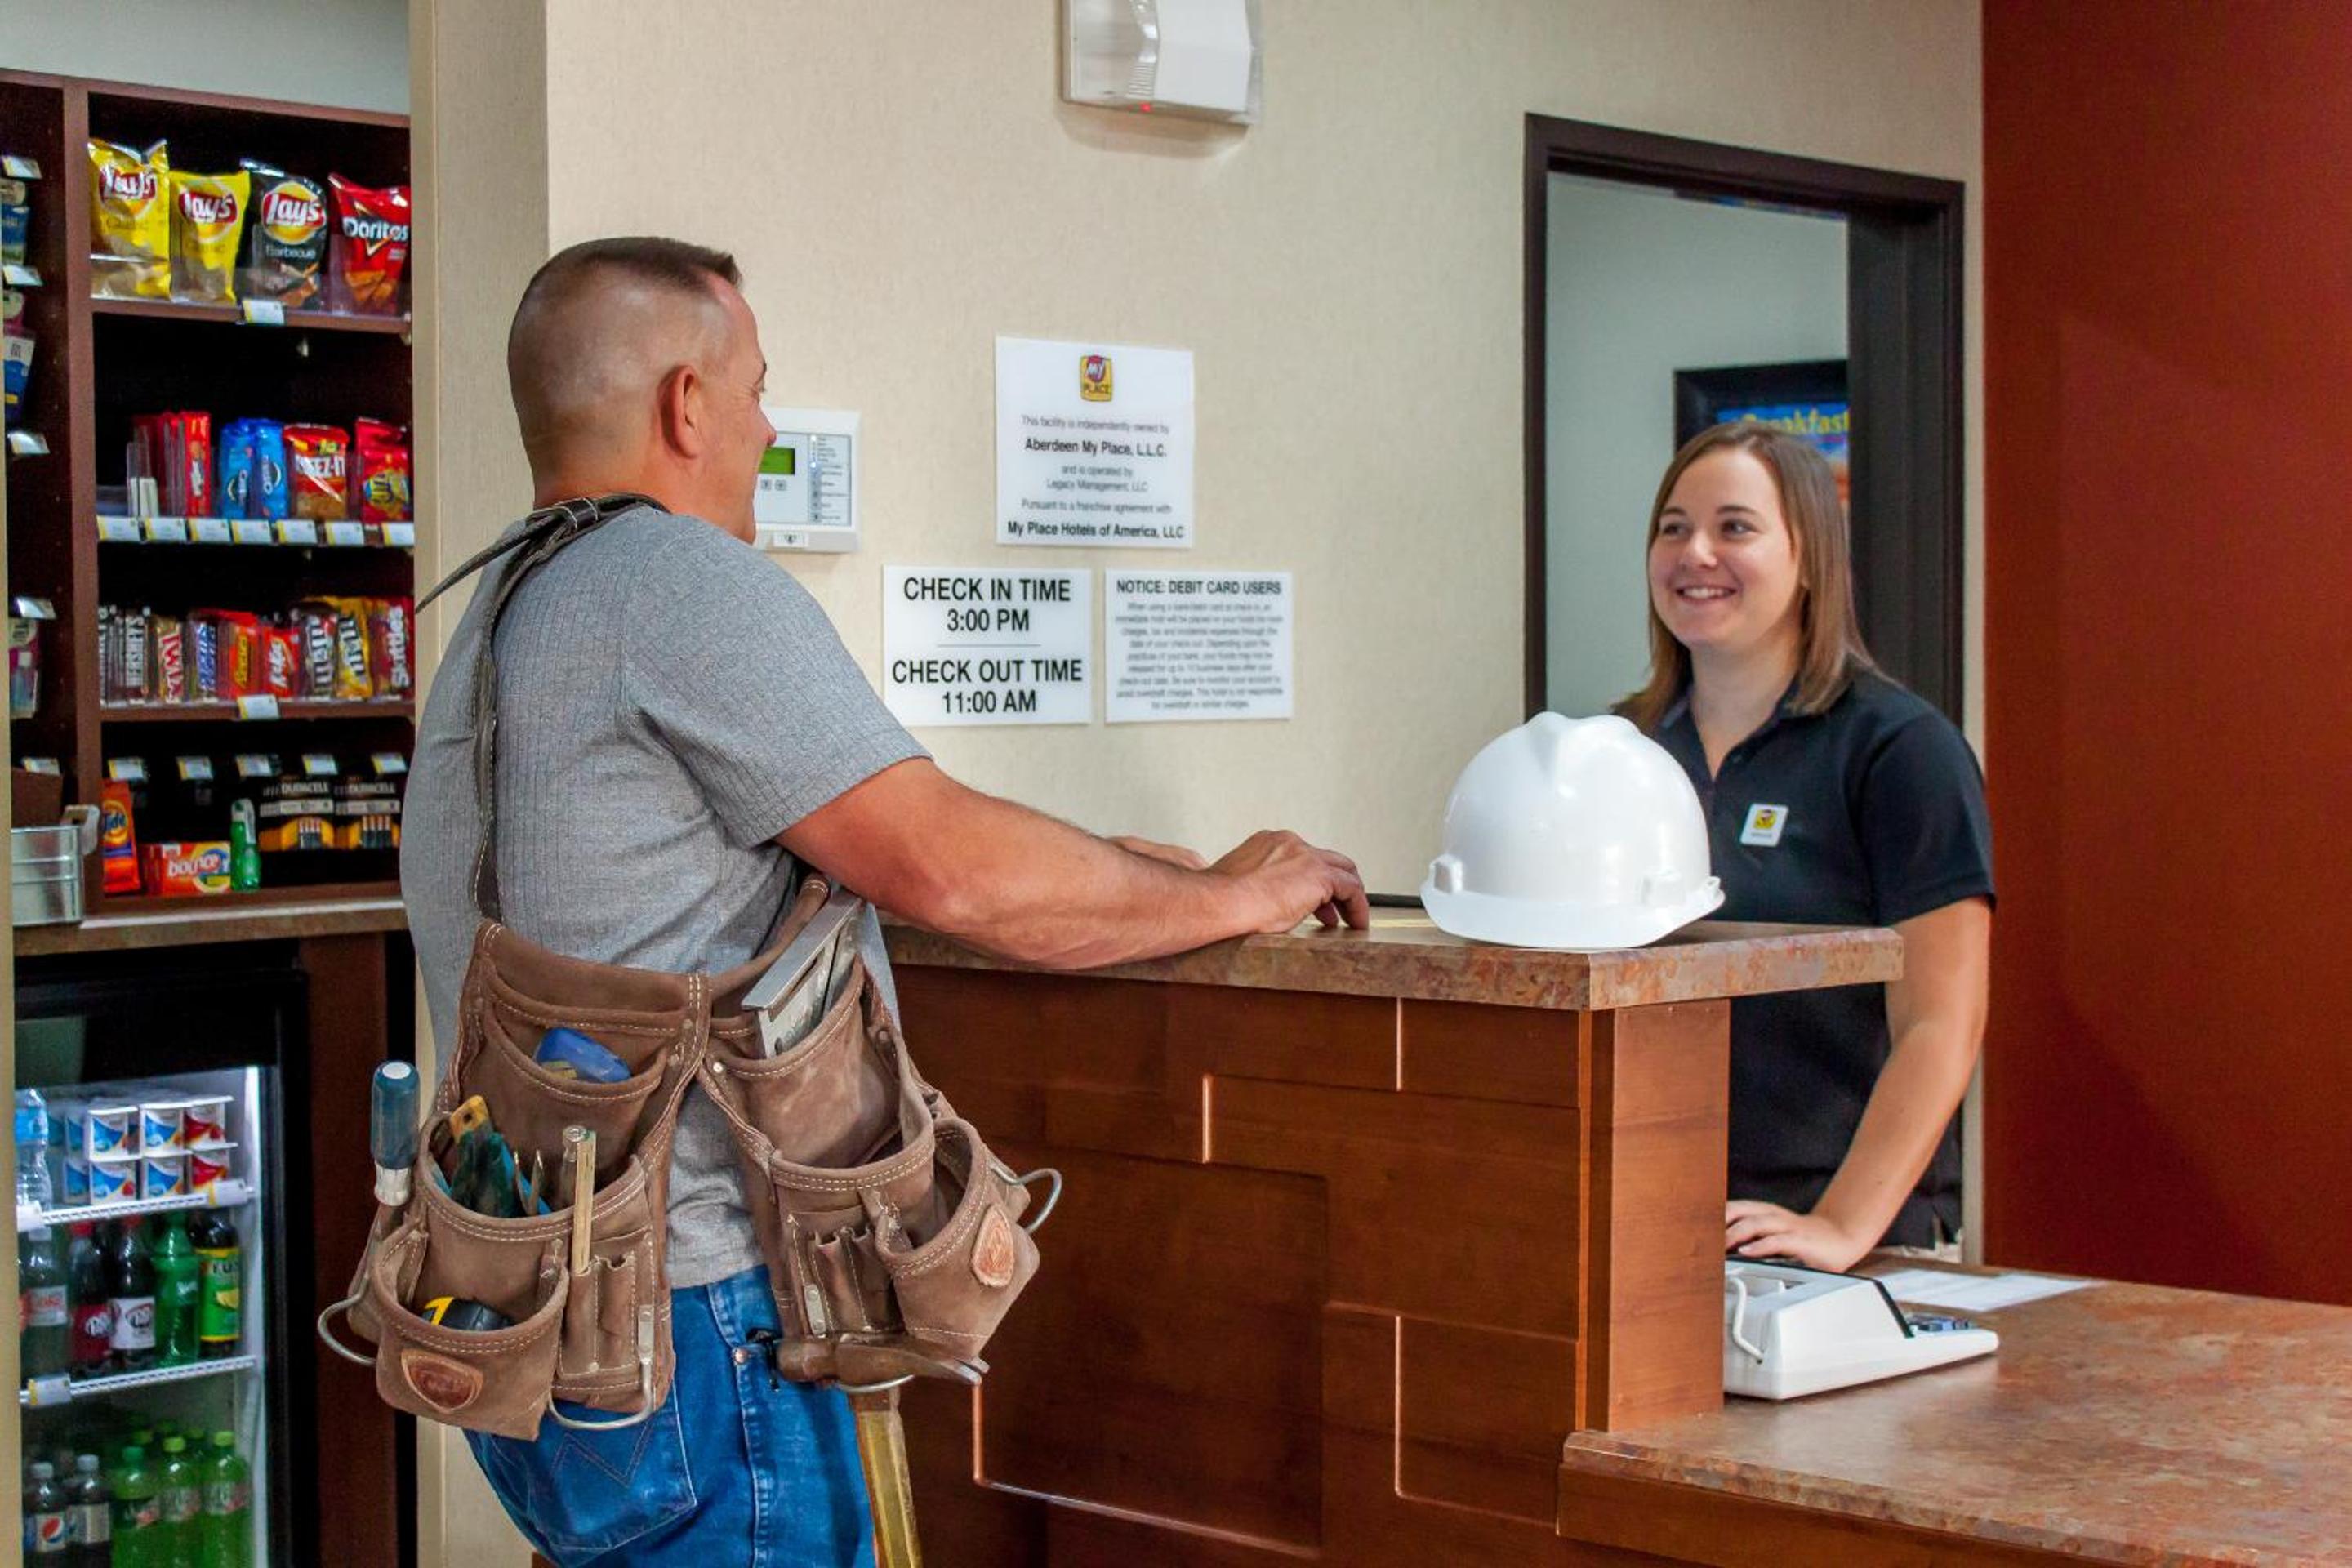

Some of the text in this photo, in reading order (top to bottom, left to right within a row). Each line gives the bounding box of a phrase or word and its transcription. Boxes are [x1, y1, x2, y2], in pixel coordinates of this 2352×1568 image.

[183, 189, 233, 223] Lay's
[266, 193, 322, 226] Lay's
[342, 216, 408, 241] Doritos
[266, 246, 316, 259] Barbecue
[1025, 438, 1078, 452] Aberdeen
[1082, 440, 1097, 457] My
[1102, 441, 1134, 456] Place,
[1008, 522, 1184, 538] My Place Hotels of America, LLC
[904, 577, 1071, 602] CHECK IN TIME
[1116, 580, 1281, 595] NOTICE: DEBIT CARD USERS
[947, 609, 1030, 632] 3:00 PM
[893, 660, 1082, 683] CHECK OUT TIME
[943, 690, 1036, 713] 11:00 AM
[167, 855, 220, 877] bounce
